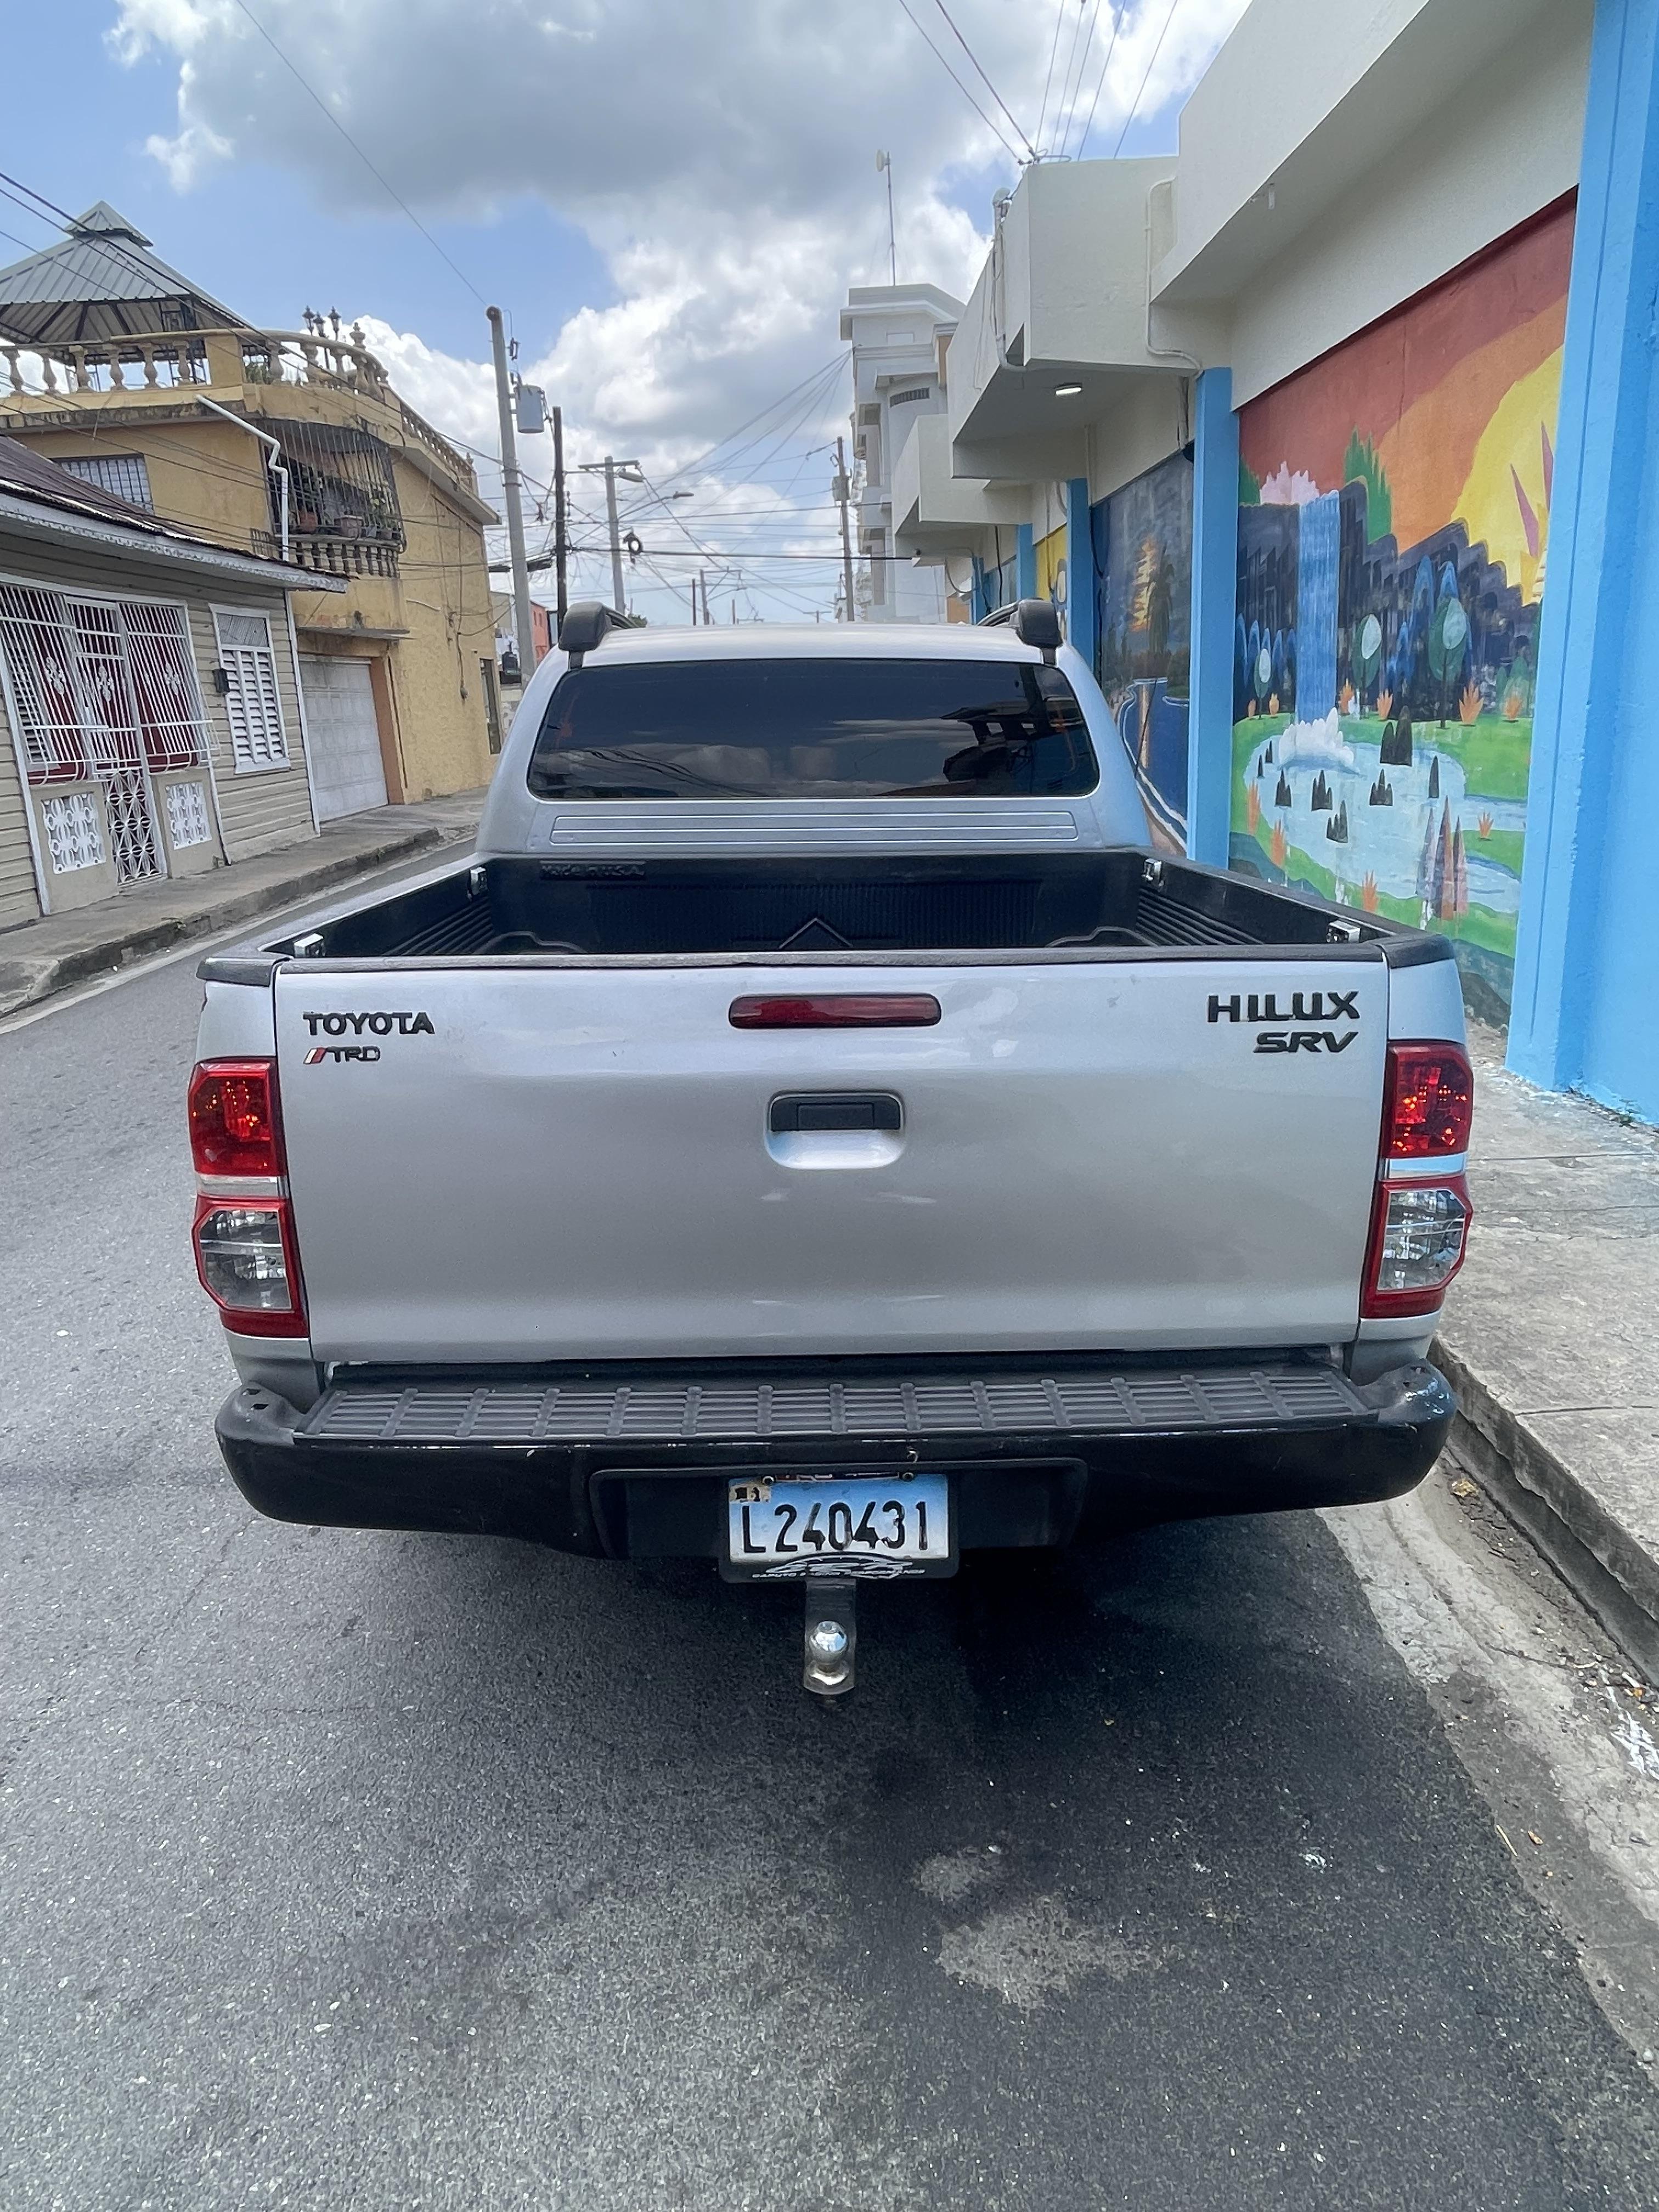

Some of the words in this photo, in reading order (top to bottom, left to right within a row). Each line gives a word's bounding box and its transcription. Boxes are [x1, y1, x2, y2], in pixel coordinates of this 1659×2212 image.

[1207, 991, 1361, 1023] HILUX
[302, 1012, 436, 1036] TOYOTA
[1253, 1031, 1359, 1053] SRV
[326, 1046, 381, 1063] TRD
[742, 1500, 928, 1554] L240431
